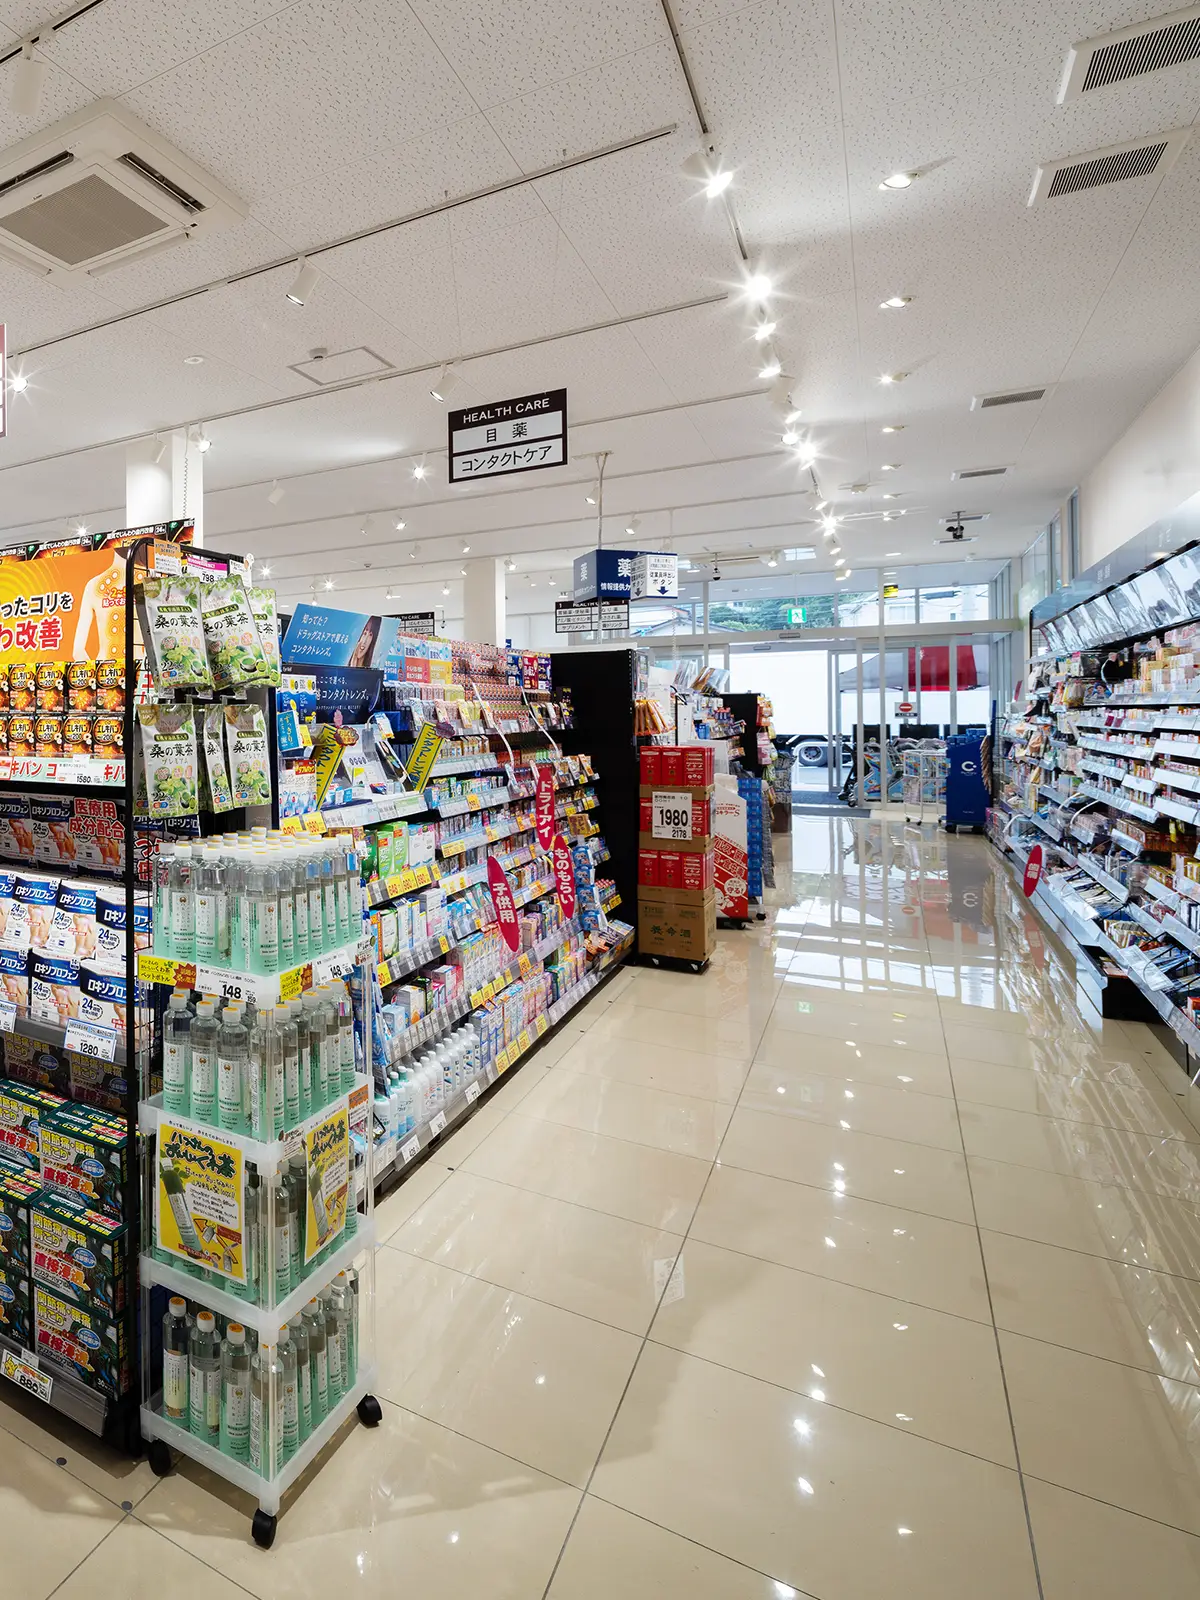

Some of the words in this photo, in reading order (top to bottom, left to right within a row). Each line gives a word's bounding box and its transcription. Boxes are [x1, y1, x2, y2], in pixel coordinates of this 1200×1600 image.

[462, 404, 512, 424] HEALTH
[515, 398, 550, 413] CARE
[461, 445, 553, 473] コンタクトケア
[202, 573, 215, 583] 798
[154, 614, 199, 630] 桑の葉茶
[150, 743, 194, 758] 桑の葉茶
[76, 775, 91, 784] 1580
[32, 806, 70, 817] ロキソプロフェン
[73, 797, 118, 819] 医療用
[537, 780, 553, 839] ドライアイ
[659, 808, 689, 827] 1980
[69, 815, 126, 840] 成分配合
[672, 829, 688, 839] 2178
[554, 848, 574, 905] ものもらい
[15, 886, 56, 900] ロキソプロフェン
[492, 882, 516, 924] 子供用
[34, 961, 79, 981] ロキソプロフェン
[329, 965, 342, 979] 148
[222, 984, 242, 1000] 148
[79, 1042, 98, 1056] 1280
